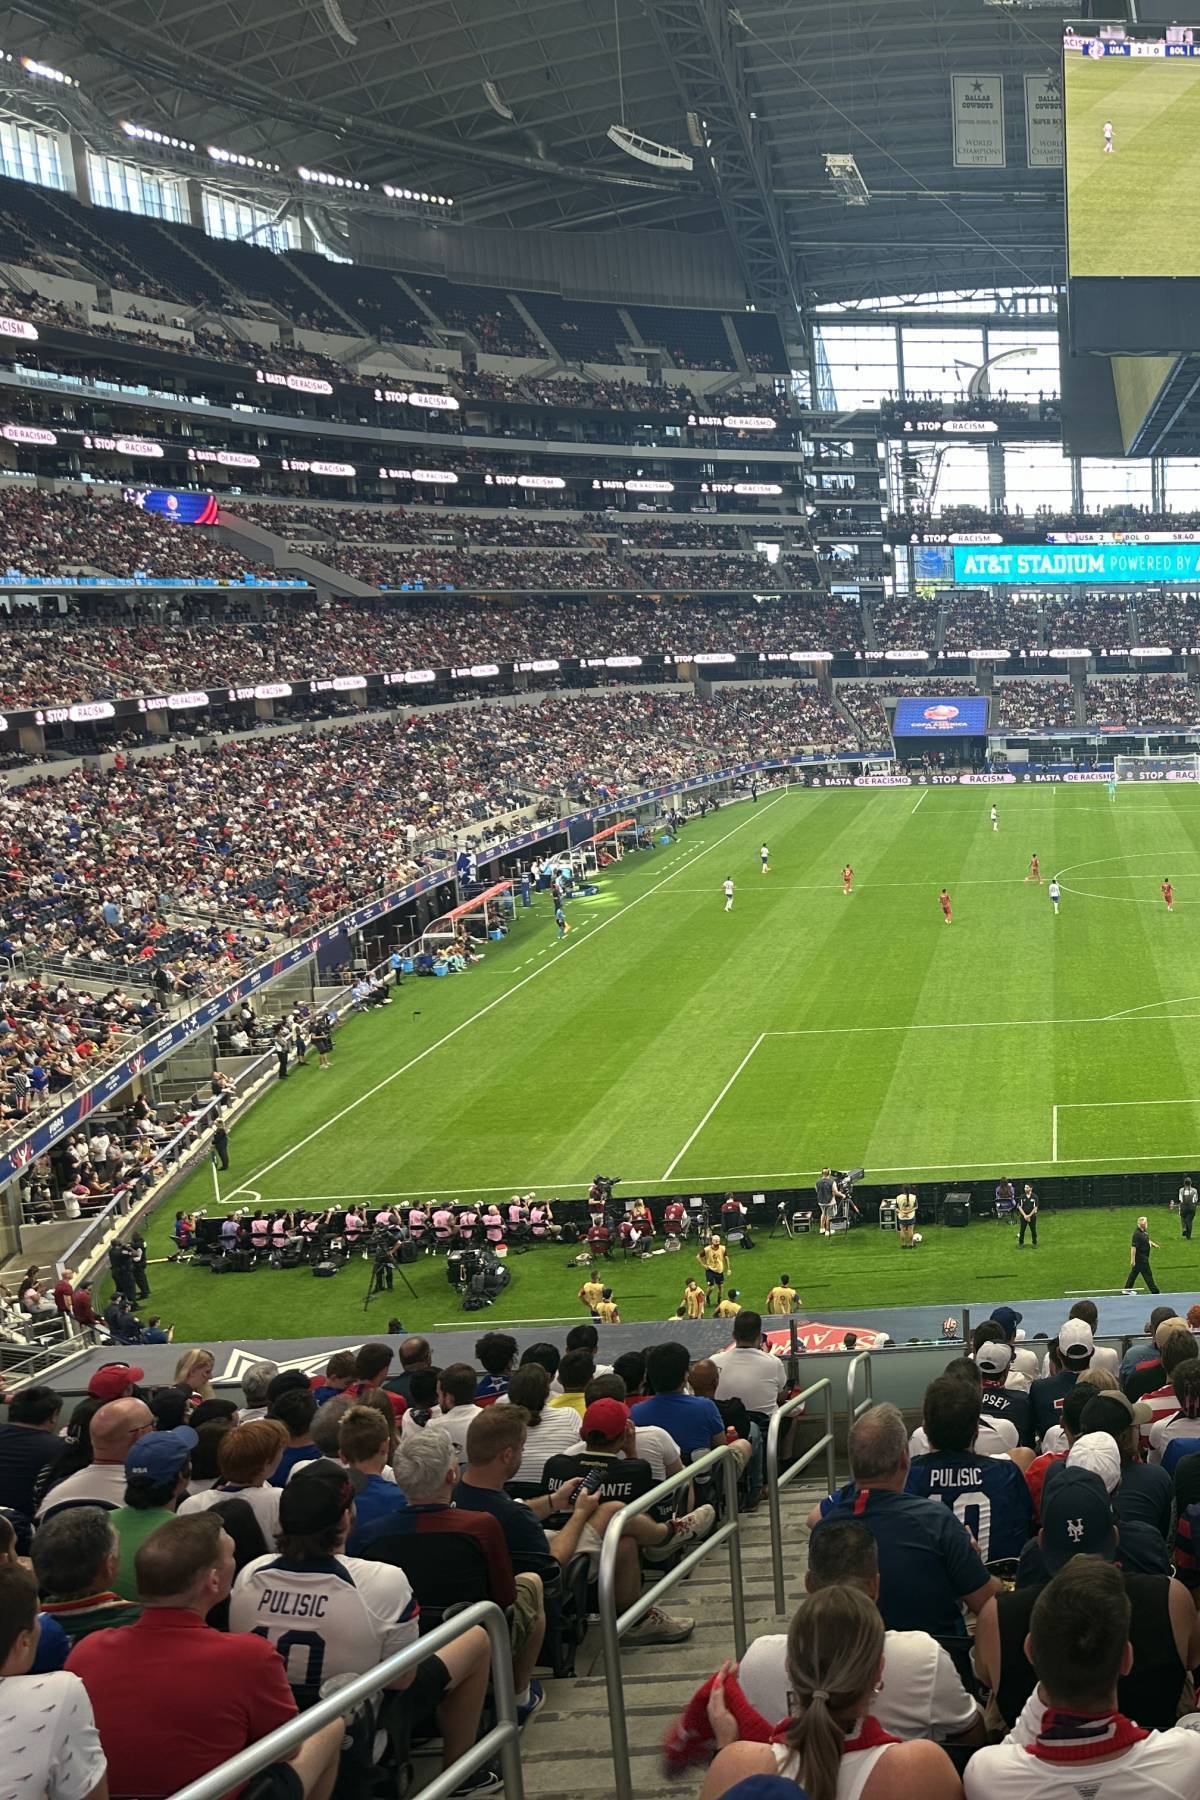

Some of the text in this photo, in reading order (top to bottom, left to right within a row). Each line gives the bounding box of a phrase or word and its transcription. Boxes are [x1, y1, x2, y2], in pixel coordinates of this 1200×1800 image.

[1109, 46, 1125, 54] USA
[0, 318, 25, 334] ACISM
[385, 391, 448, 406] STOP RACISM
[699, 417, 722, 425] BASTA
[917, 422, 941, 431] STOP
[8, 429, 52, 441] DE RACISMO
[95, 439, 152, 452] STOP RACISM
[291, 461, 346, 473] STOP RACISM
[496, 476, 517, 484] STOP
[712, 484, 733, 492] STOP
[923, 534, 946, 543] STOP
[964, 555, 1012, 574] AT&T
[1018, 556, 1105, 574] STADIUM
[1110, 556, 1172, 572] POWERED
[1177, 556, 1191, 570] BY
[237, 689, 254, 699] STOP
[47, 710, 68, 722] STOP
[982, 1394, 1010, 1410] PSEY
[930, 1467, 982, 1487] PULISIC
[548, 1478, 632, 1496] BUANTE
[928, 1492, 991, 1565] 0
[258, 1589, 328, 1617] PULISIC
[250, 1626, 326, 1685] 0
